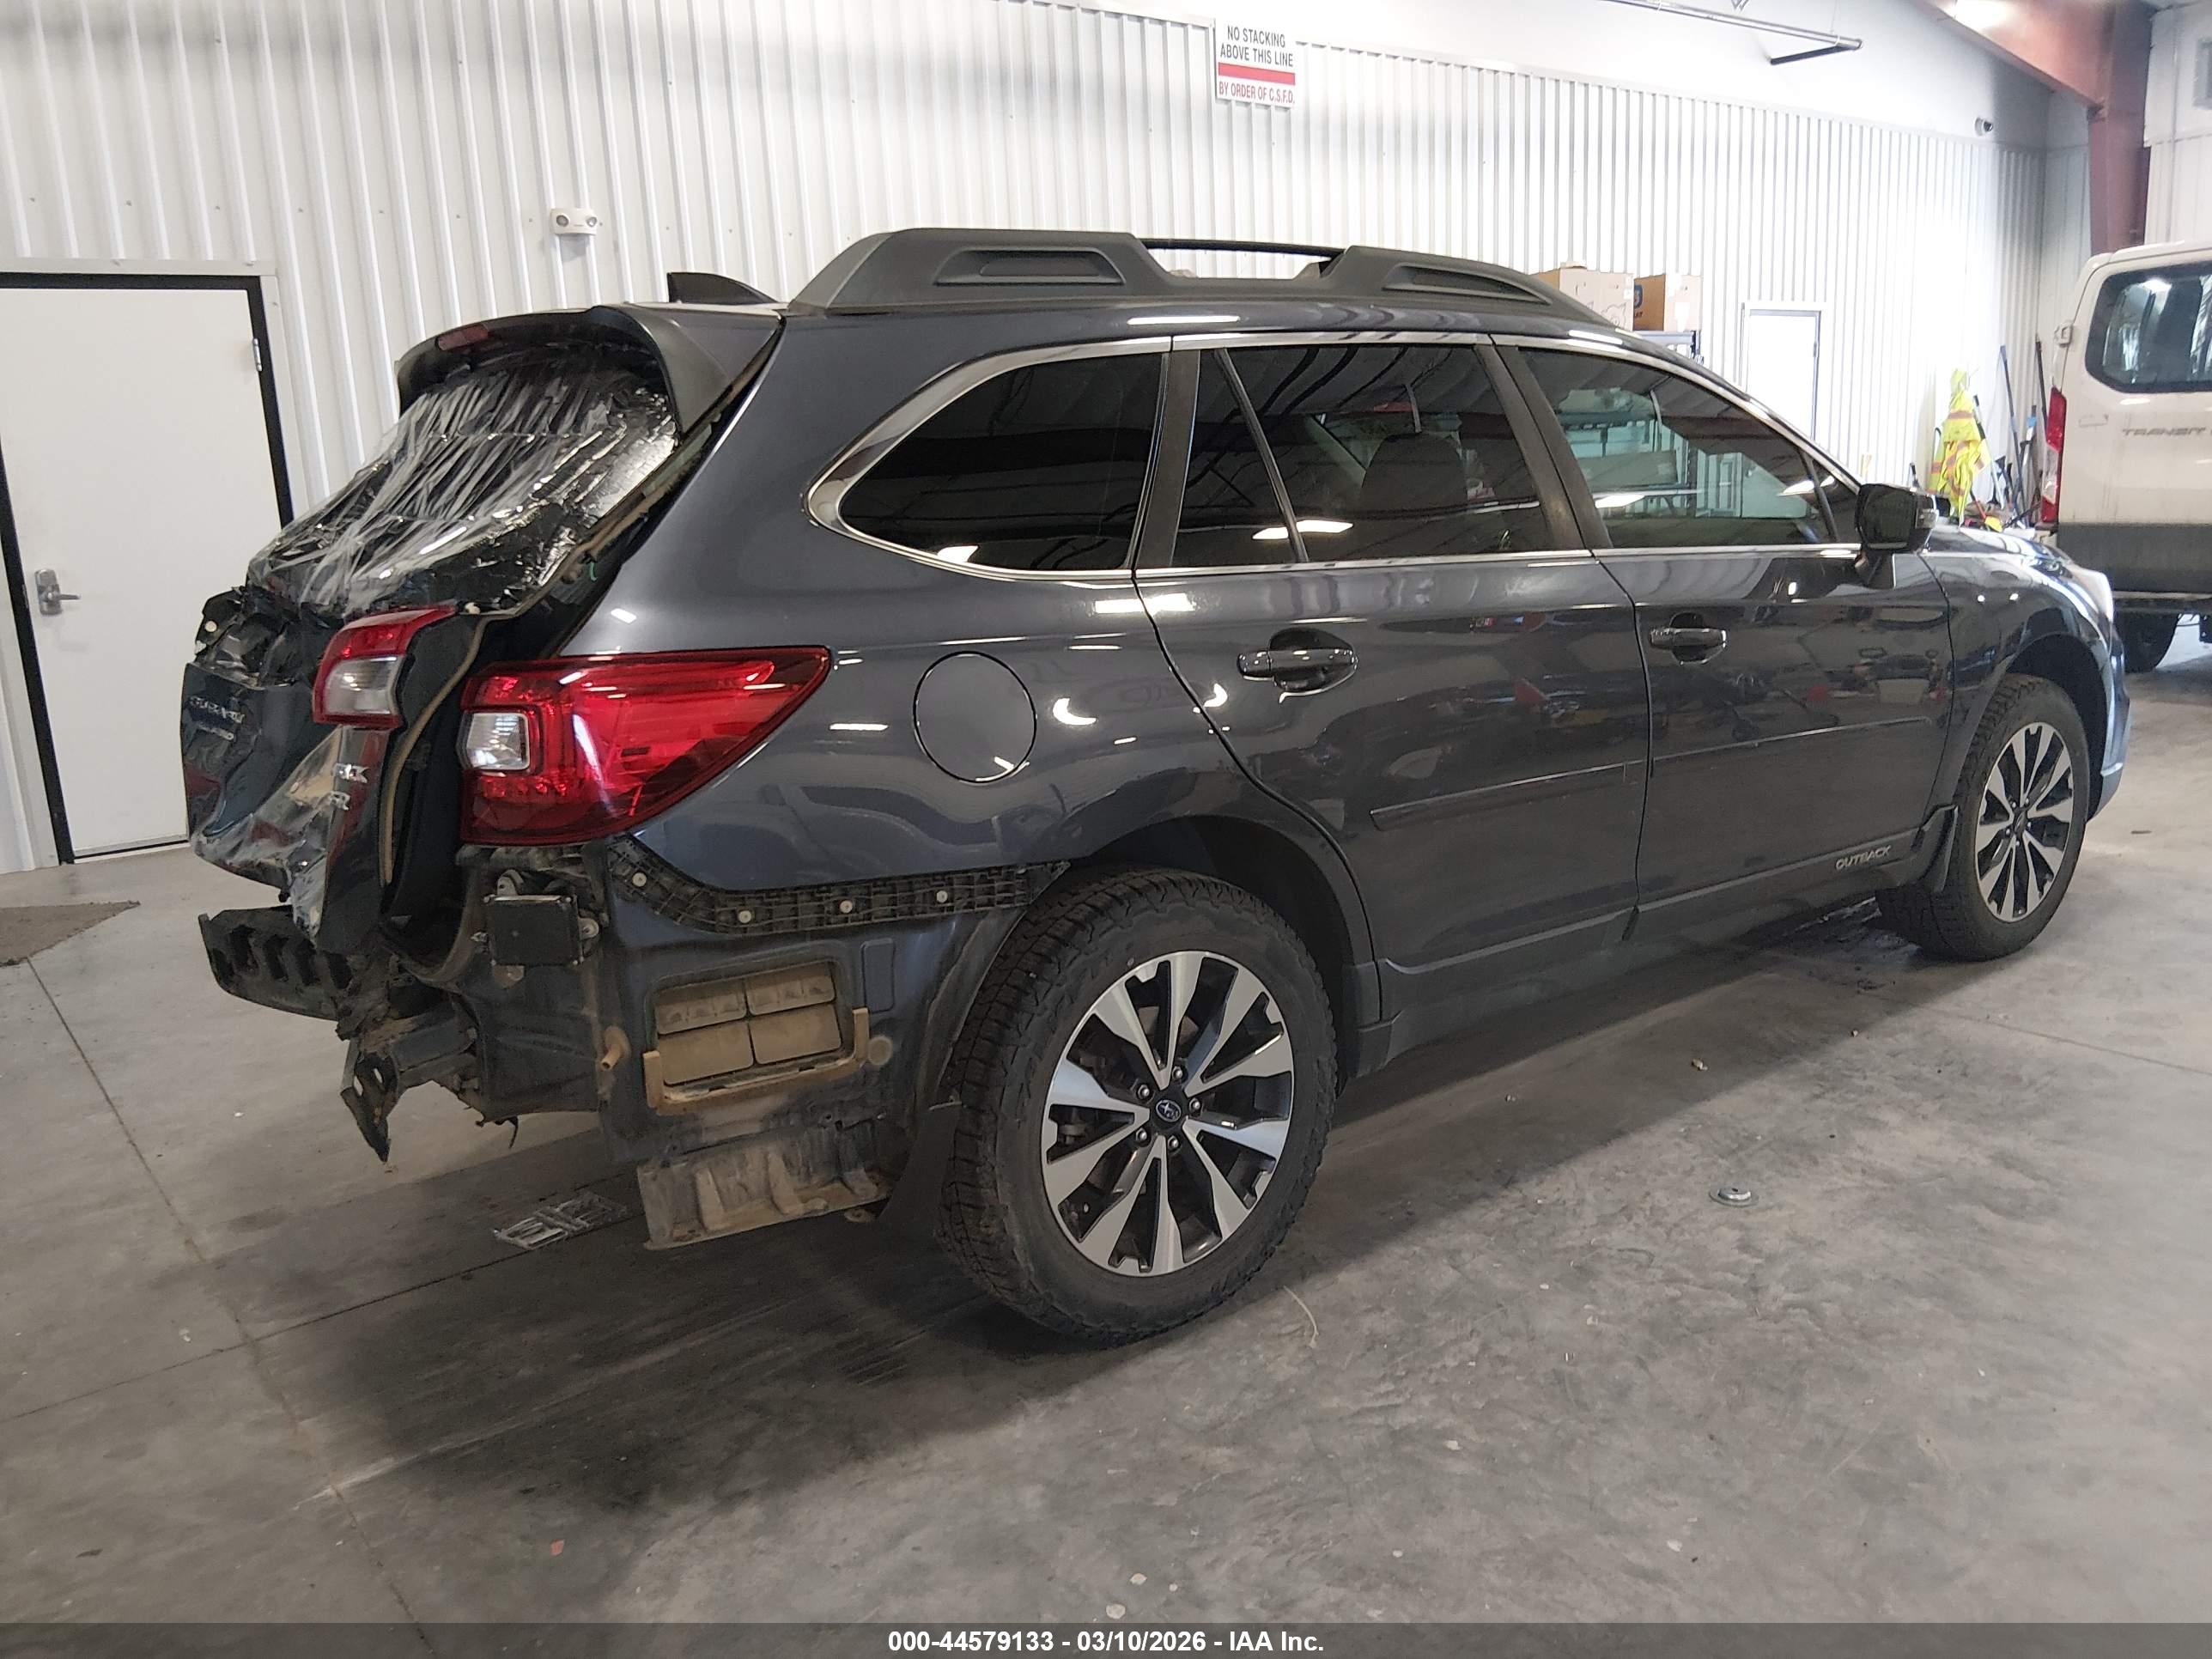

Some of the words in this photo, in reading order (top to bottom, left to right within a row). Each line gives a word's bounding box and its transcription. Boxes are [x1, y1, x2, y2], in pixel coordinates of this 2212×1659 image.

[1227, 25, 1240, 41] NO
[1243, 27, 1285, 48] STACKING
[1220, 43, 1249, 61] ABOVE
[1253, 48, 1272, 64] THIS
[1274, 52, 1293, 67] LINE
[1218, 81, 1229, 95] BY
[1231, 82, 1255, 99] ORDER
[1257, 86, 1267, 101] OF
[1268, 88, 1295, 104] C.S.F.D.
[1835, 844, 1892, 871] OUTBACK
